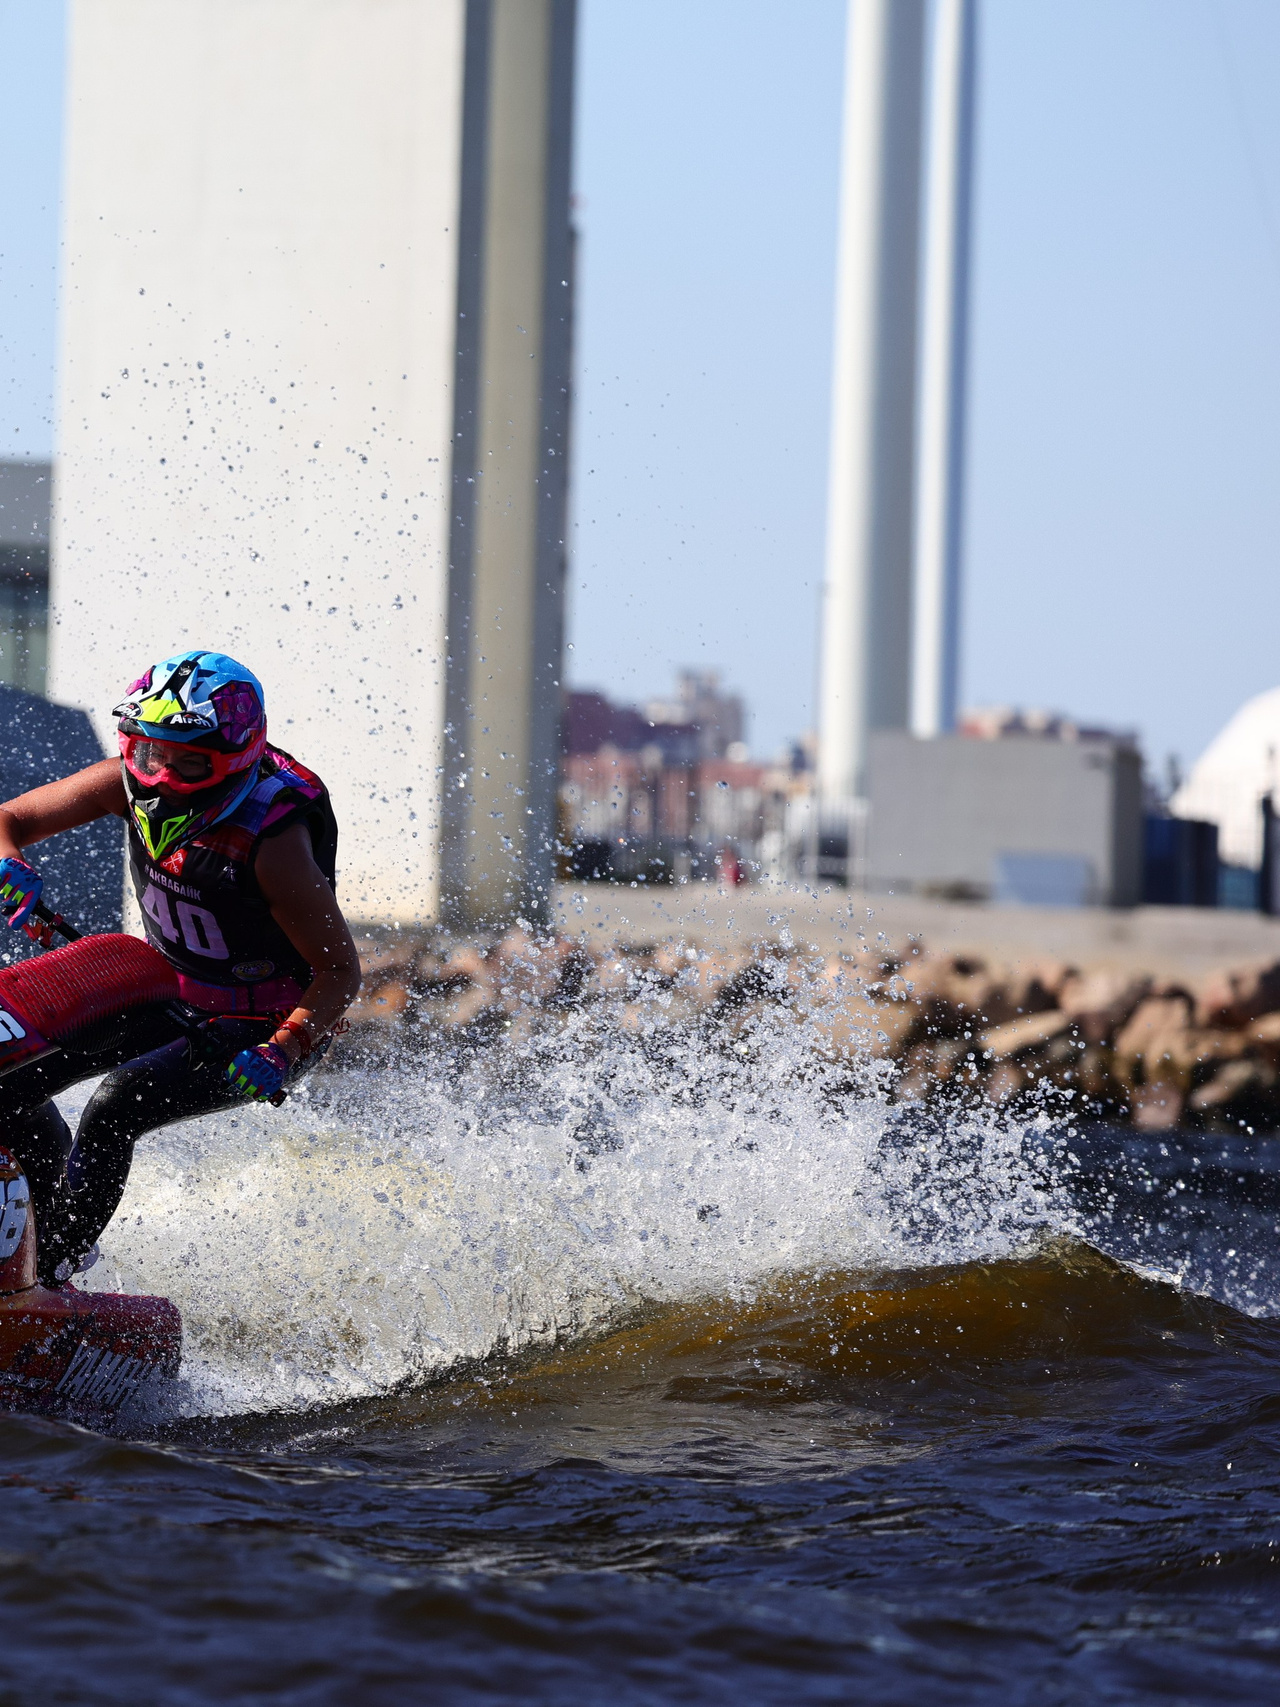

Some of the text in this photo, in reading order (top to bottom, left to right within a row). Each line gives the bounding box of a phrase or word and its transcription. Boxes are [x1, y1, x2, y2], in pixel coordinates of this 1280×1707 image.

[144, 863, 202, 901] #АКВАБАЙК
[141, 882, 230, 960] 40
[54, 1342, 150, 1406] YAMAH
